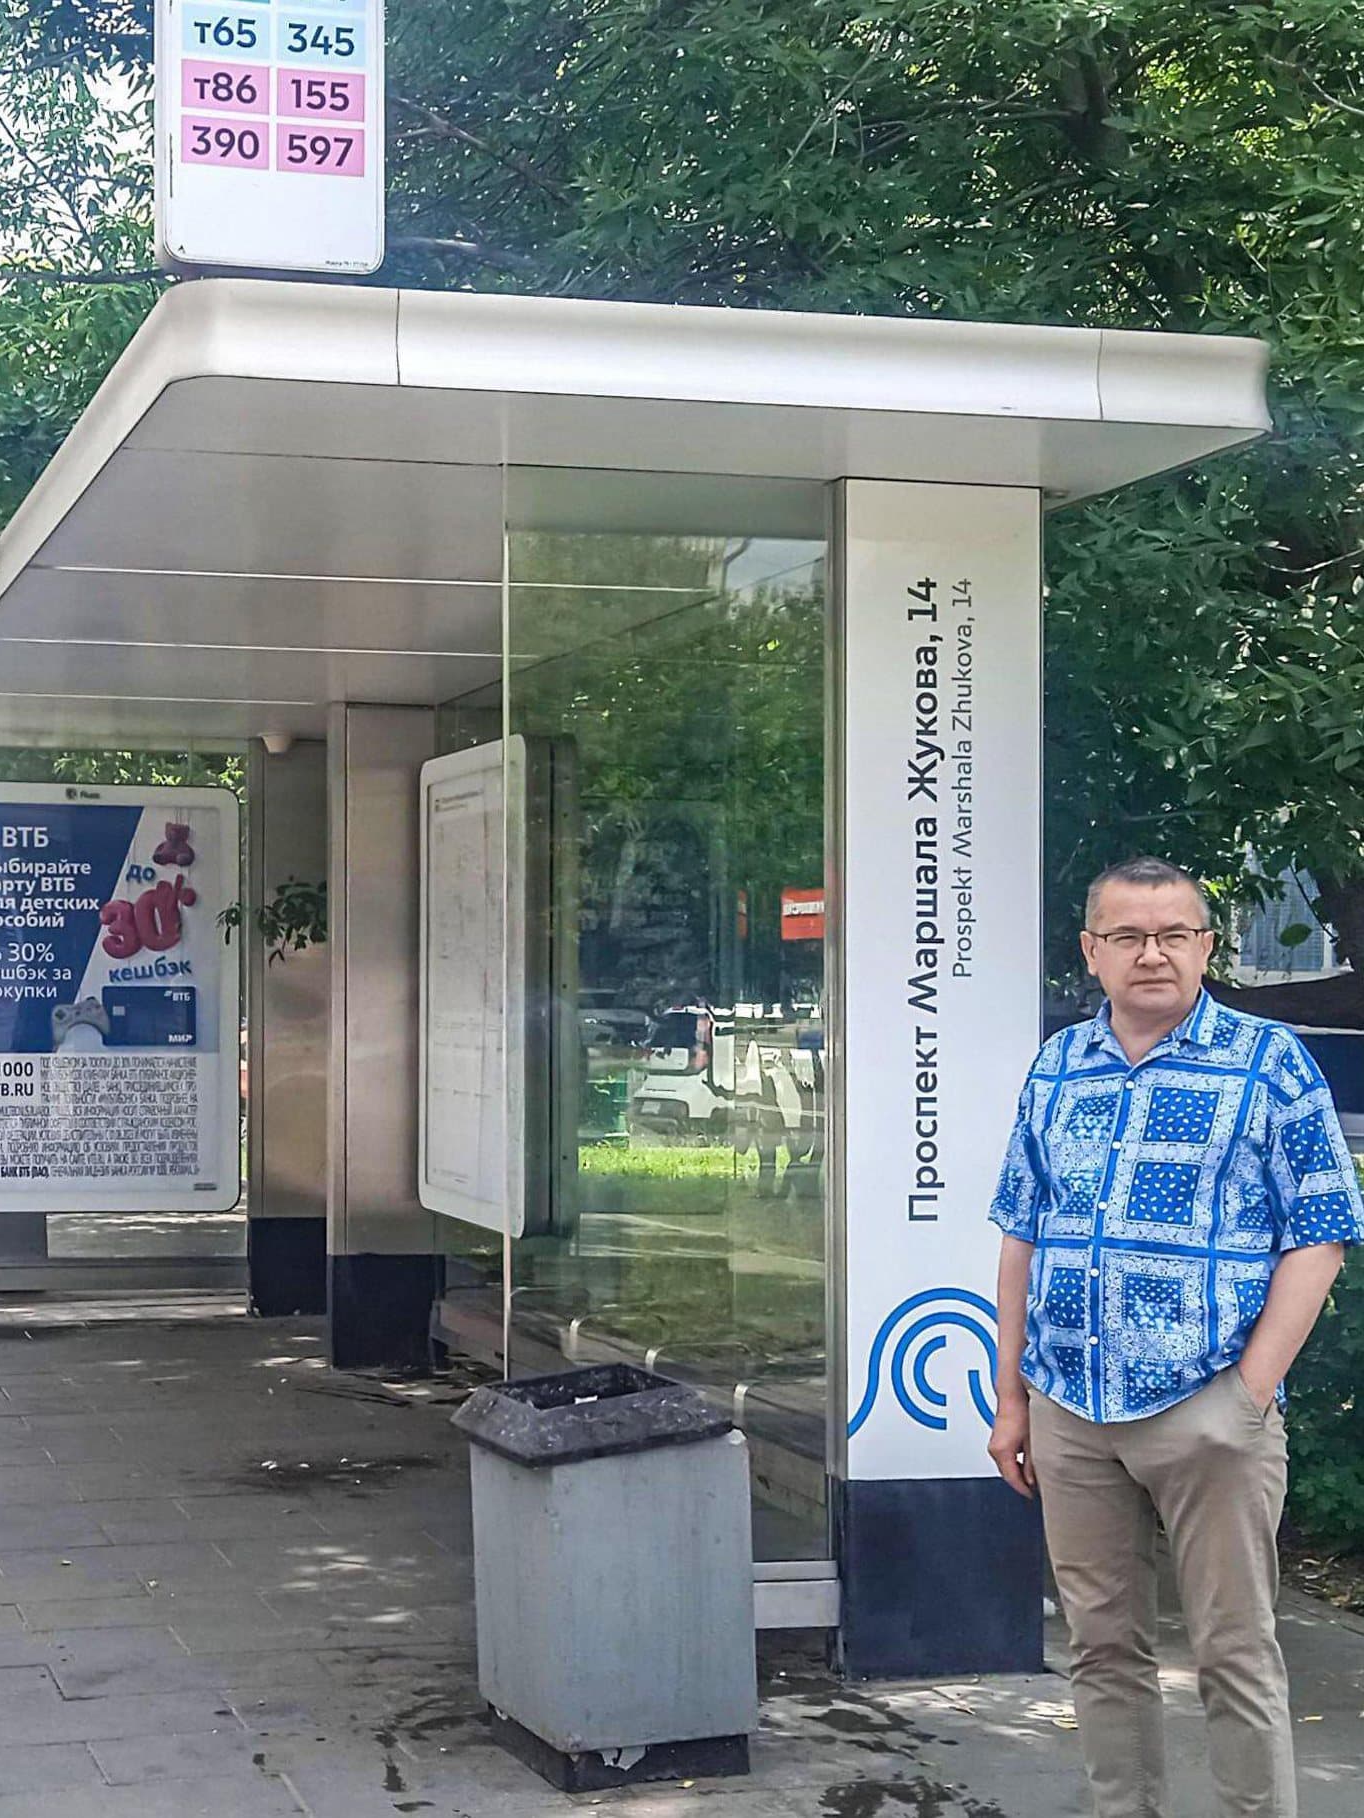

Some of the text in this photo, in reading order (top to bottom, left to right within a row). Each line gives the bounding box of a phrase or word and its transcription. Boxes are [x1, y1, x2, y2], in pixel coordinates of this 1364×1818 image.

[287, 22, 355, 56] 345
[290, 79, 350, 112] 155
[191, 125, 260, 160] 390
[287, 133, 354, 167] 597
[951, 577, 977, 977] Prospekt Marshala Zhukova, 14
[2, 826, 49, 848] ВТБ
[40, 876, 76, 892] ВТБ
[125, 863, 156, 884] до
[20, 897, 100, 913] детских
[907, 577, 945, 1221] Проспект Маршала Жукова, 14
[7, 942, 55, 963] 30%
[52, 967, 72, 980] за
[108, 956, 192, 984] кешбэк
